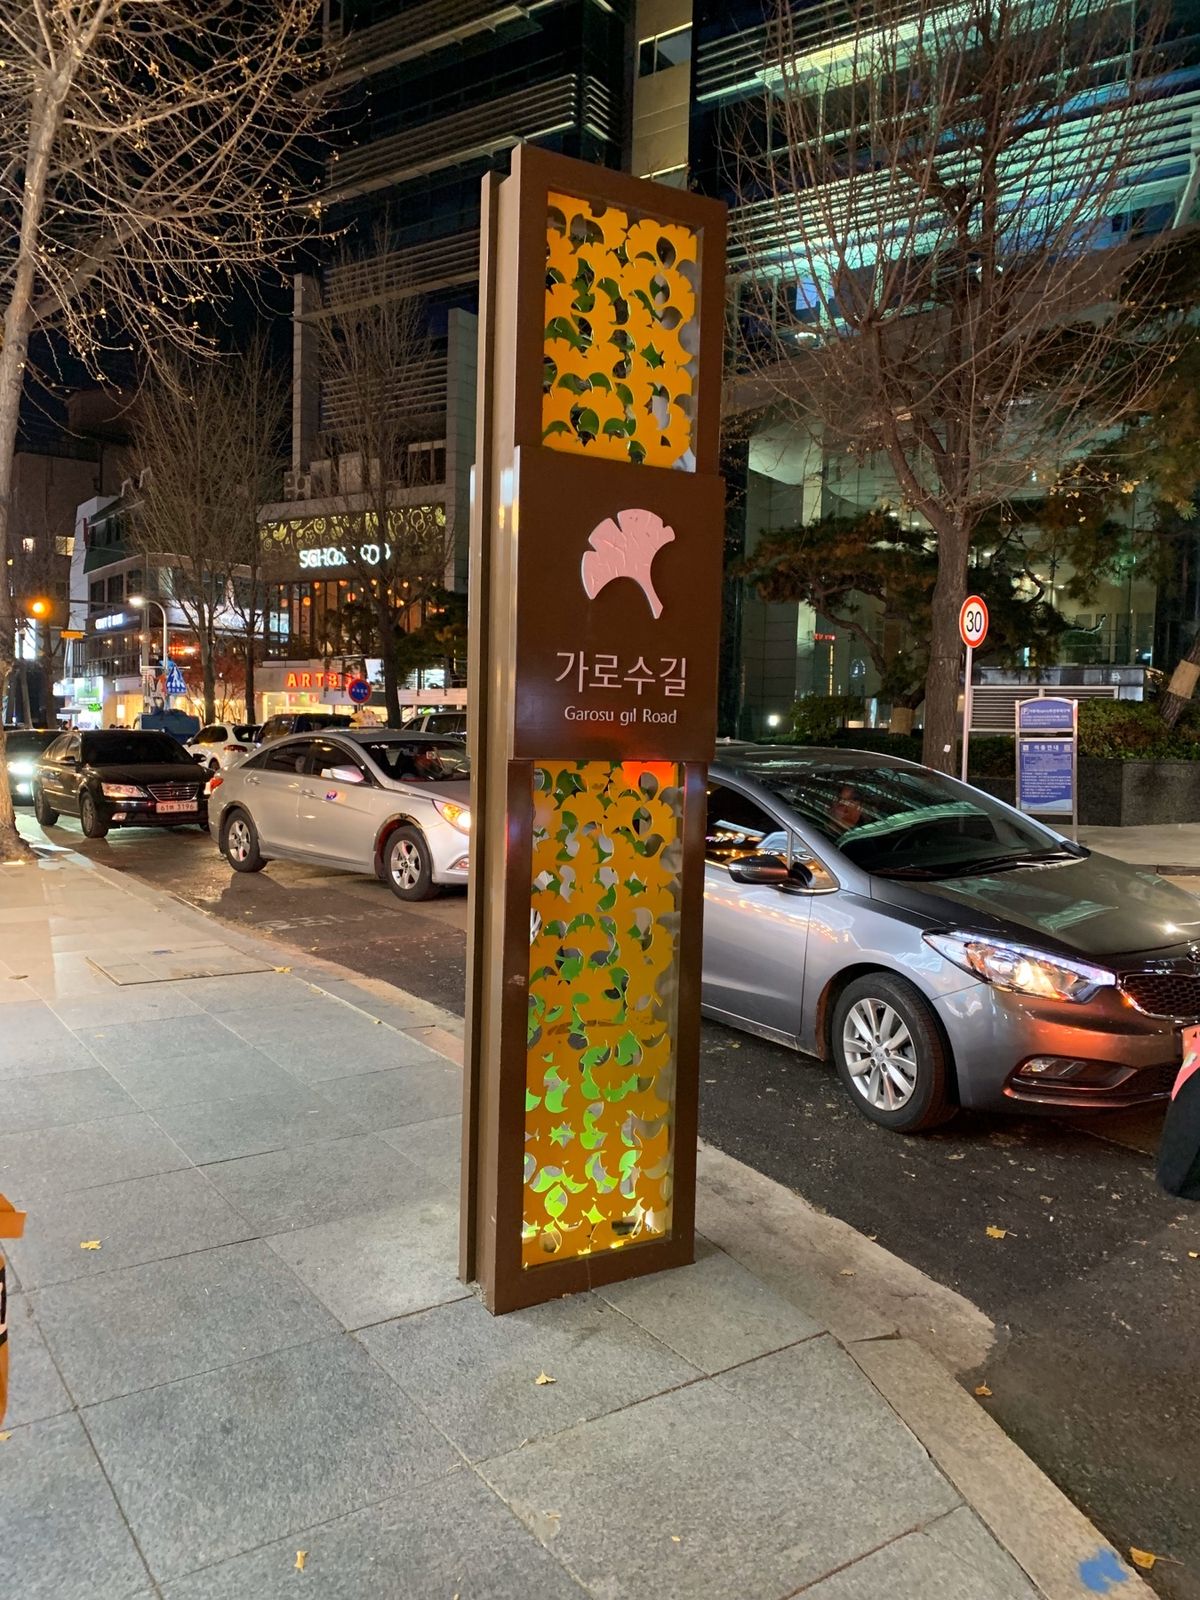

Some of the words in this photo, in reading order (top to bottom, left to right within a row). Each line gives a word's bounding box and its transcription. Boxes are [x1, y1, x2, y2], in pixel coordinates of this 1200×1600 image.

[966, 610, 982, 633] 30
[555, 651, 686, 697] 가로수길
[564, 706, 614, 721] Garosu
[620, 708, 637, 726] gil
[643, 709, 677, 724] Road
